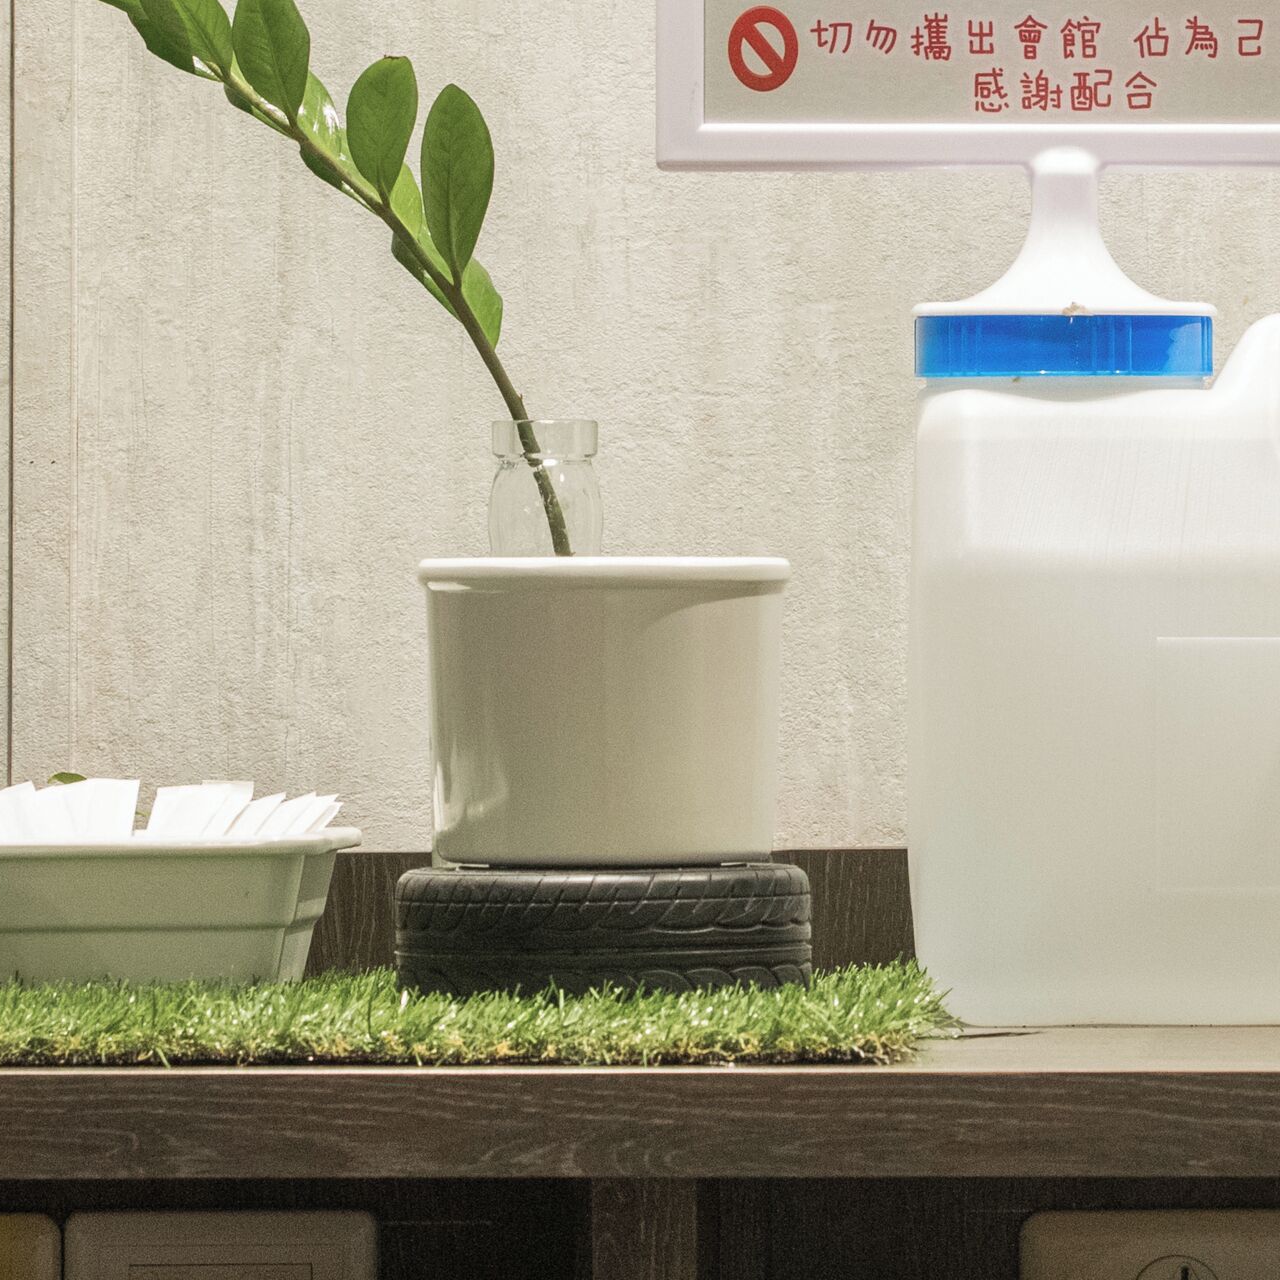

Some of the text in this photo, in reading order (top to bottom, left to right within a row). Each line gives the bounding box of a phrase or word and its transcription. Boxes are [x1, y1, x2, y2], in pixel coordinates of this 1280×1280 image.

[810, 12, 1102, 61] 切勿攜出會館
[973, 67, 1158, 112] 感謝配合
